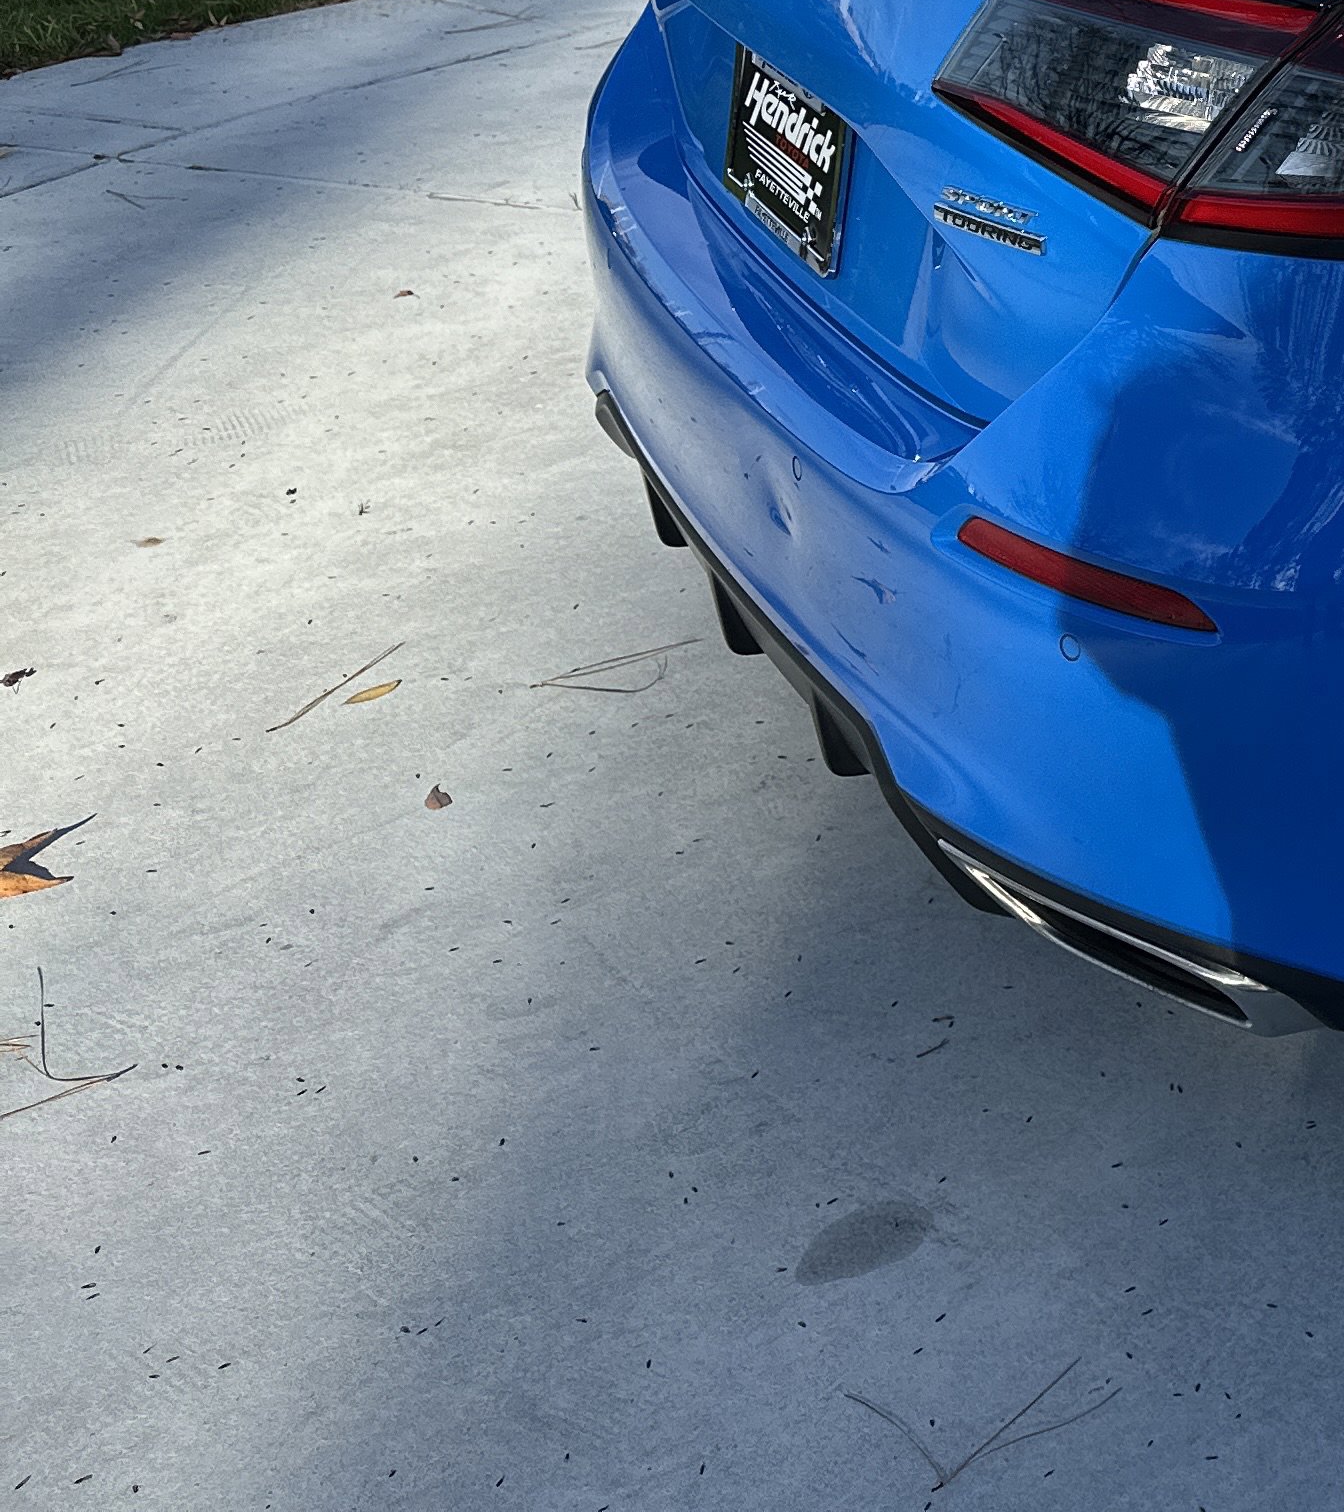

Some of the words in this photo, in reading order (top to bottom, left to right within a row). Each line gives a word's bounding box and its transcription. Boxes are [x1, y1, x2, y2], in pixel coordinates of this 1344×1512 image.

[744, 71, 836, 174] Hendrick
[775, 133, 810, 169] TOYOTA
[755, 168, 811, 224] FAYETTEVILLE
[942, 185, 1040, 224] SPORT
[938, 204, 1038, 253] TOURING
